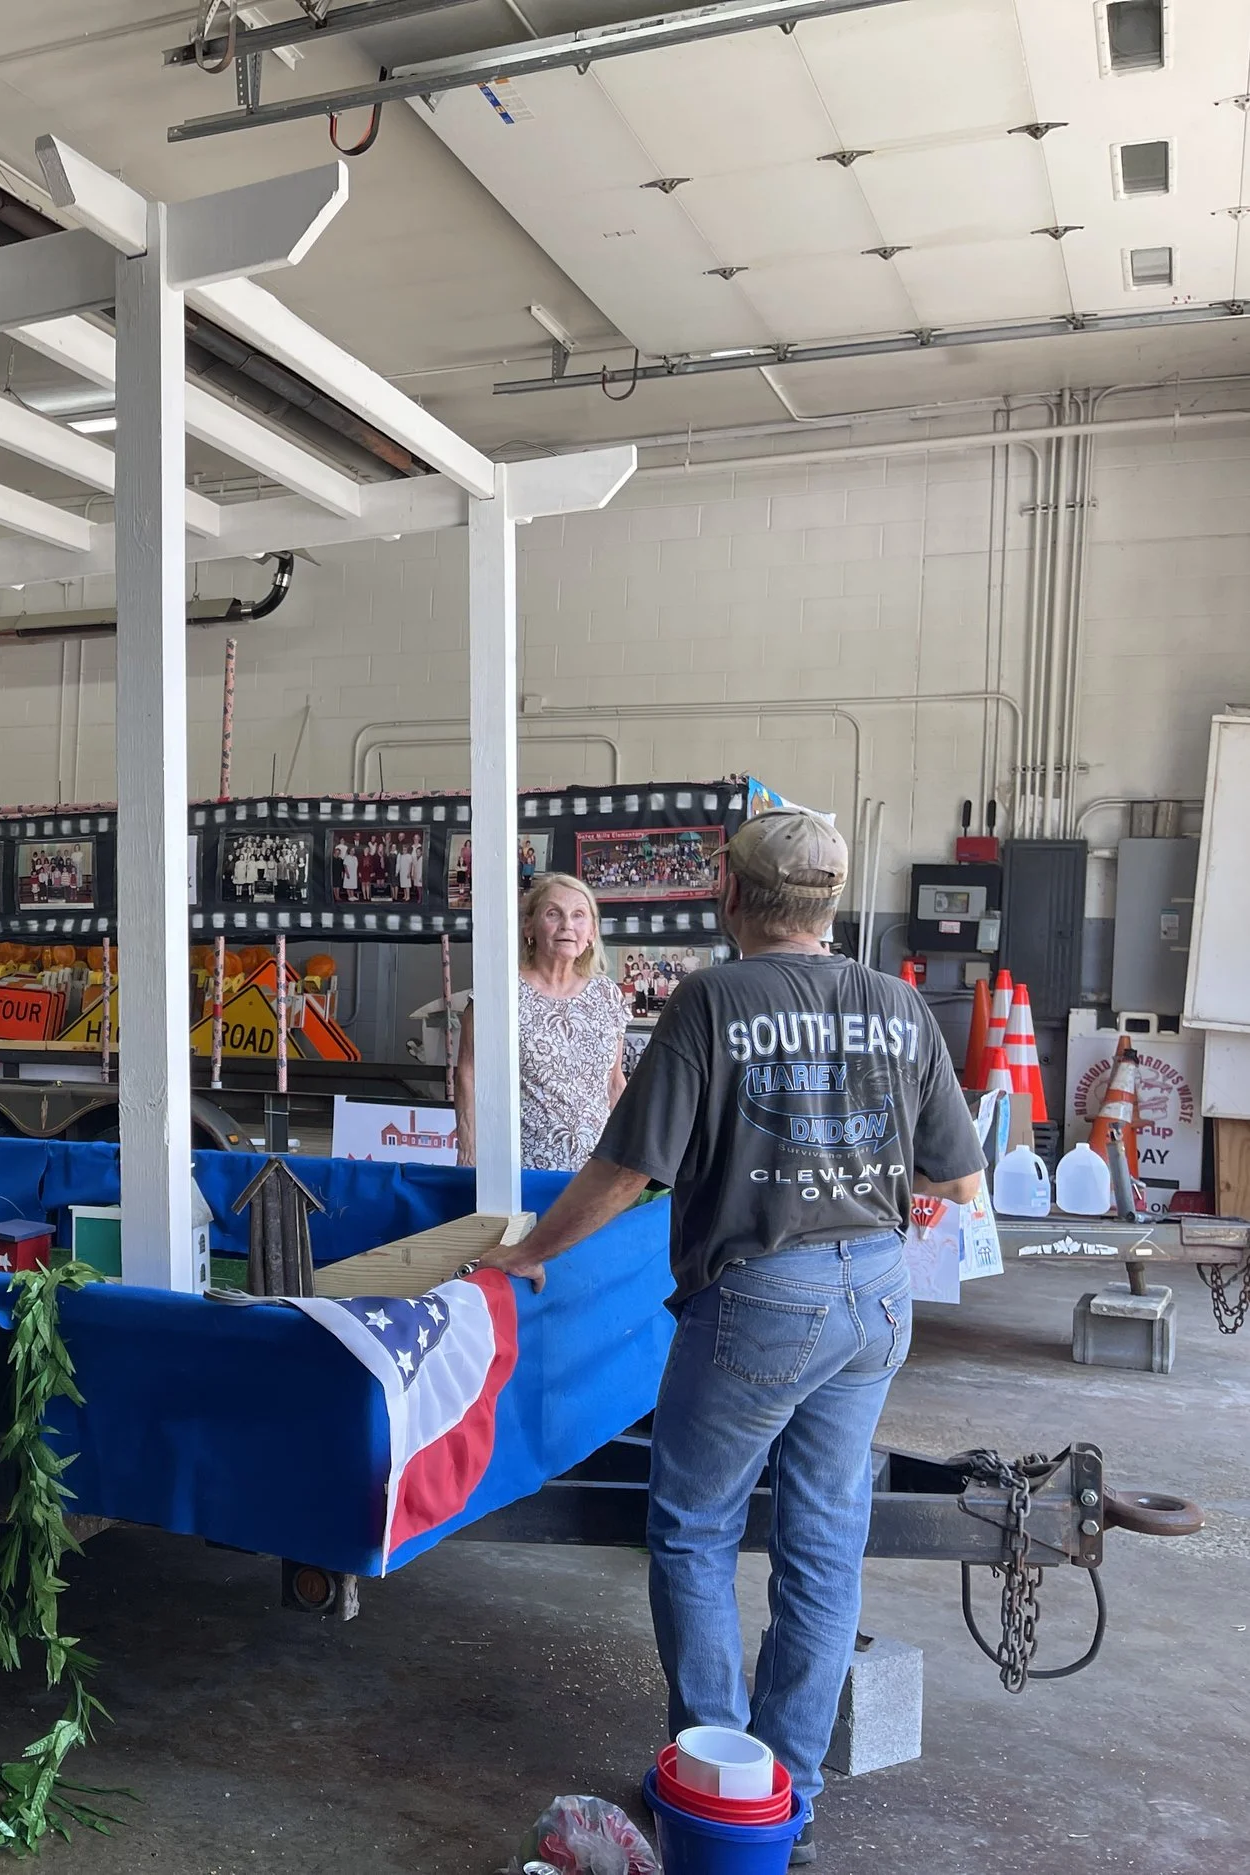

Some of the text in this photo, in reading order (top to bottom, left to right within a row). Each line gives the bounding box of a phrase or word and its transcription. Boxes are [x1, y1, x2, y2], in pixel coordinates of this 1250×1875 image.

[215, 1022, 274, 1053] ROAD
[728, 1011, 919, 1063] SOUTHEAST
[751, 1064, 846, 1093] HARLEY
[1074, 1054, 1194, 1123] HOUSEHOLD ARDOUS WASTE
